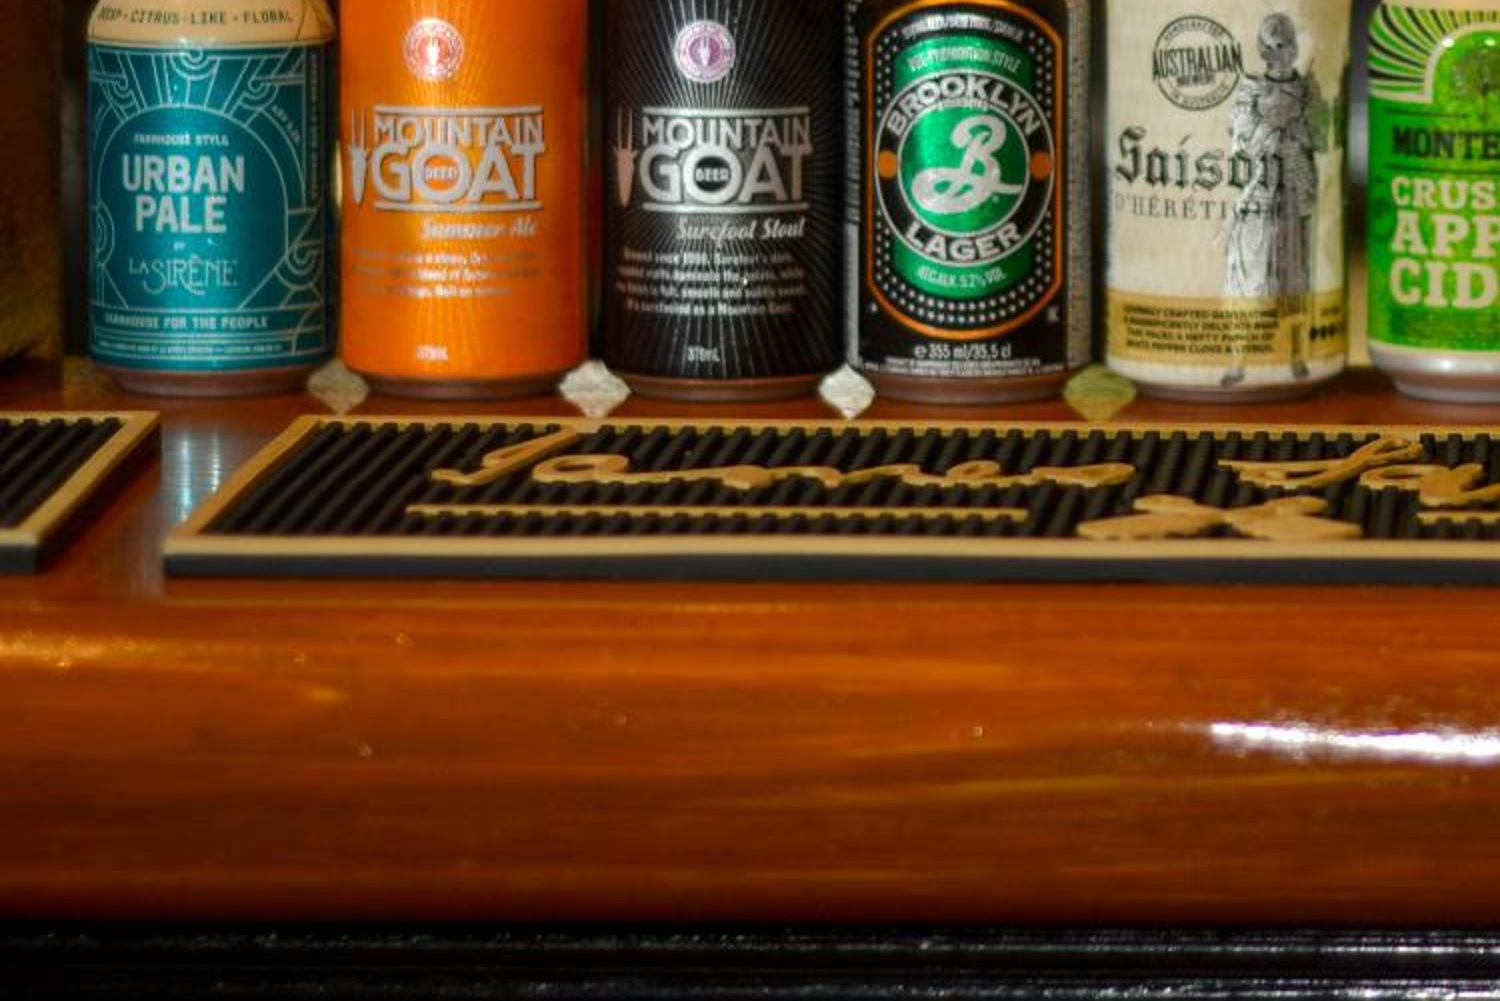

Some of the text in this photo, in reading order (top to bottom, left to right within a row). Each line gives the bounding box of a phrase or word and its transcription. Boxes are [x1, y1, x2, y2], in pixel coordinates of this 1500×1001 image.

[1152, 41, 1245, 81] AUSTRALIAN
[886, 72, 1041, 137] BROOKLYN
[375, 115, 544, 150] MOUNTAIN
[643, 116, 811, 150] MOUNTAIN
[121, 153, 246, 195] URBAN
[371, 142, 546, 204] GOAT
[639, 142, 815, 205] GOAT
[695, 167, 729, 183] BEER
[911, 114, 1024, 215] B
[135, 195, 228, 234] PALE
[761, 215, 806, 241] Stout
[905, 221, 1022, 262] LAGER
[192, 315, 218, 330] THE
[221, 313, 269, 330] PEOPLE
